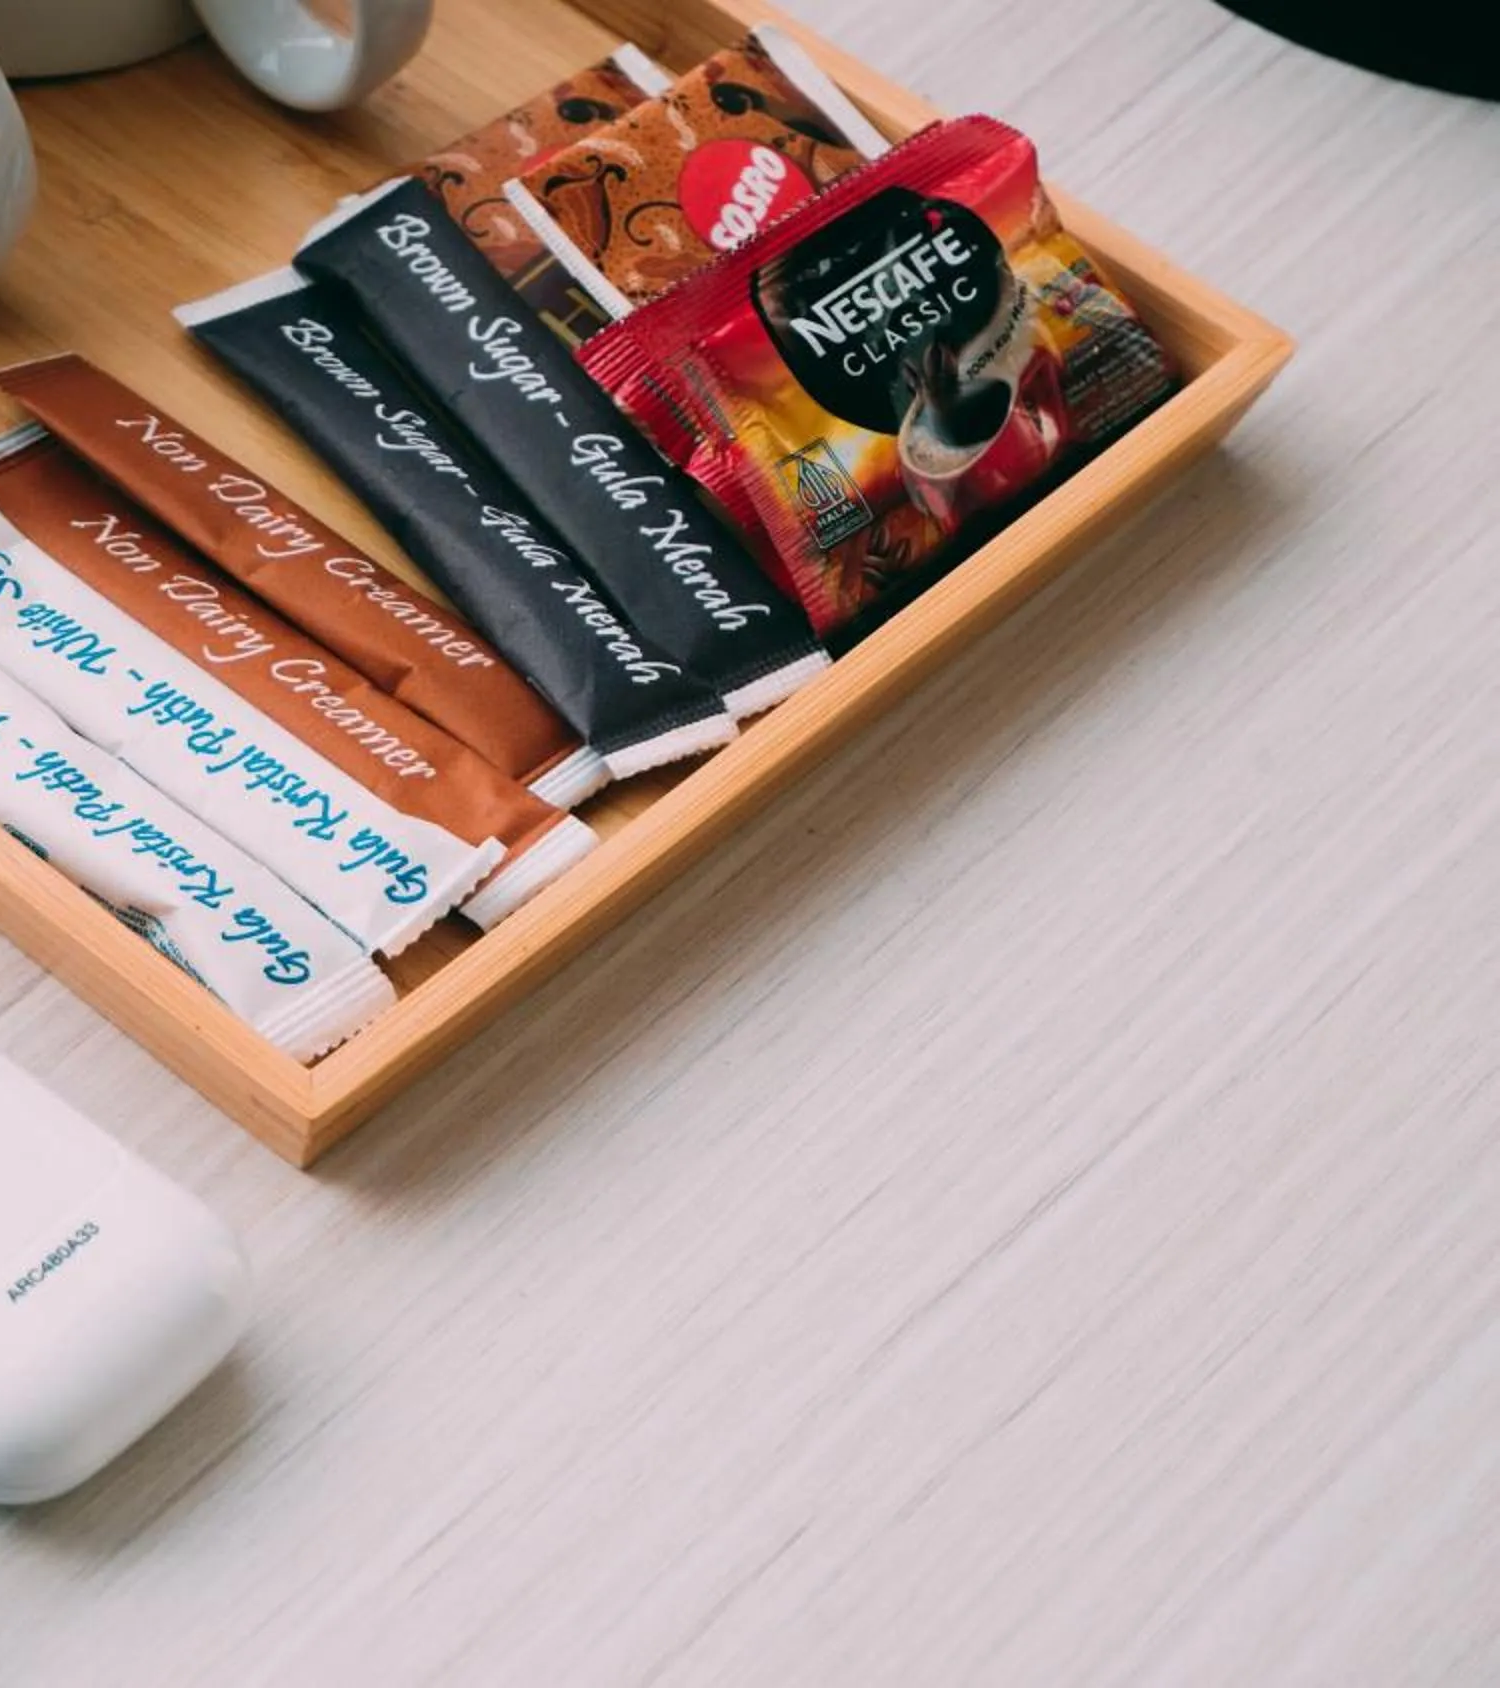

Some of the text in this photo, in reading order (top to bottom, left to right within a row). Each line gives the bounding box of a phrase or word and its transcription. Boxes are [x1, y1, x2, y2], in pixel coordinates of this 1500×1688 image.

[710, 146, 787, 251] SOSRO
[843, 276, 978, 376] CLASSIC
[377, 214, 477, 313] Brown
[469, 315, 563, 417] Sugar
[571, 433, 665, 511] Gula
[641, 509, 770, 632] Merah
[116, 415, 496, 671] Non Dairy Creamer
[280, 318, 380, 398] Brown
[375, 403, 469, 485] Sugar
[482, 504, 570, 568] Gula
[552, 577, 681, 685] Merah
[816, 502, 856, 529] HALAL
[17, 603, 117, 674] White
[71, 514, 437, 779] Non Dairy Creamer
[127, 680, 235, 757] Putih
[15, 750, 125, 826] Putih
[205, 744, 349, 842] Kristal
[94, 818, 234, 910] Kristal
[339, 826, 429, 905] Gula
[221, 906, 311, 986] Gula
